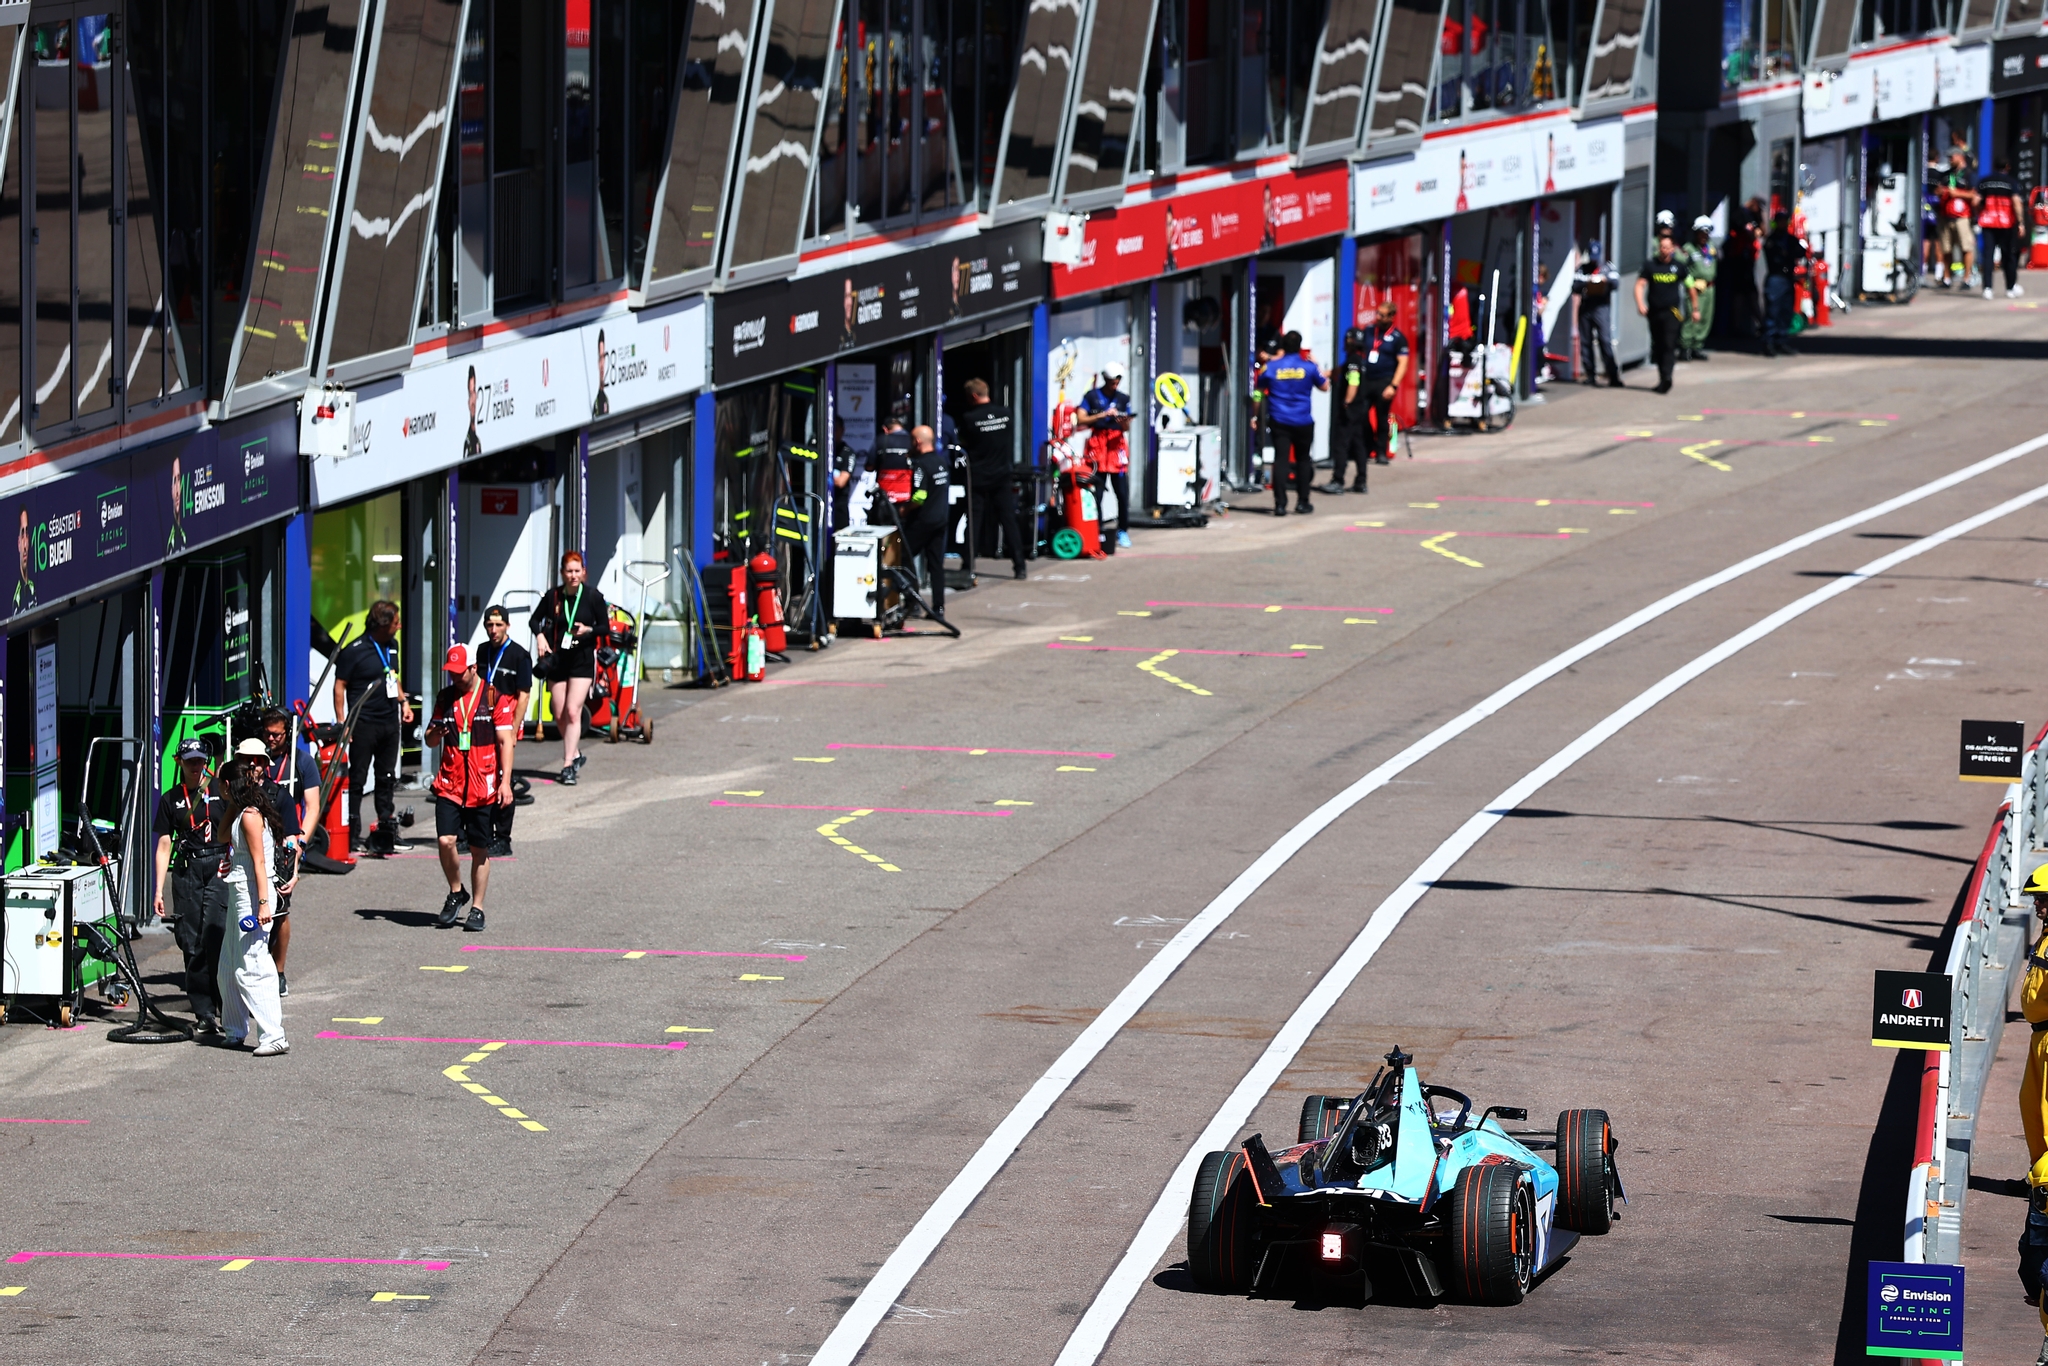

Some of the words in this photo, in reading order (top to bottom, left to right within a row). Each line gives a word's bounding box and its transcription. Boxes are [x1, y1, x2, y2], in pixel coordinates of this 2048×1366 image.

[618, 358, 648, 383] DRUGOVICH
[476, 385, 491, 424] 27
[493, 397, 514, 420] DENNIS
[194, 467, 206, 487] JOEL
[179, 471, 194, 520] 14
[194, 482, 225, 515] ERIKSSON
[107, 502, 123, 521] Envision
[49, 513, 77, 539] SÉBASTIEN
[31, 522, 48, 573] 16
[49, 537, 72, 568] BUEMI
[1971, 755, 2011, 763] PENSKE
[1879, 1013, 1944, 1028] ANDRETTI
[1379, 1123, 1392, 1150] 33
[1903, 1289, 1951, 1302] Envision
[1880, 1305, 1951, 1315] RACING
